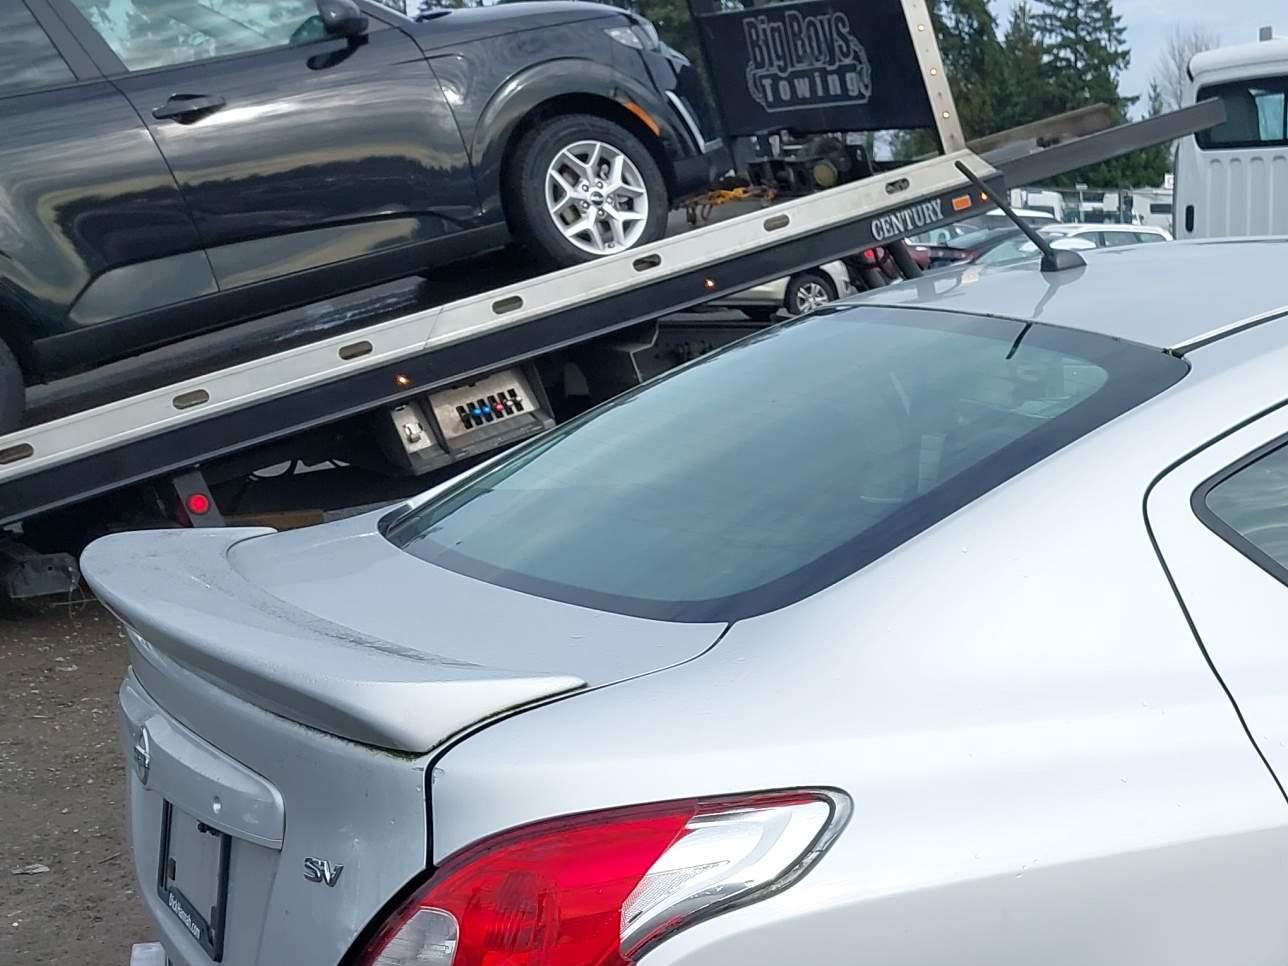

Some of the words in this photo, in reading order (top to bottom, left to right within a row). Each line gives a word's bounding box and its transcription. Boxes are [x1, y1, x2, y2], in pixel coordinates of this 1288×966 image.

[743, 16, 790, 76] Big
[762, 72, 859, 102] Towing
[871, 199, 944, 240] CENTURY
[303, 857, 344, 887] SV
